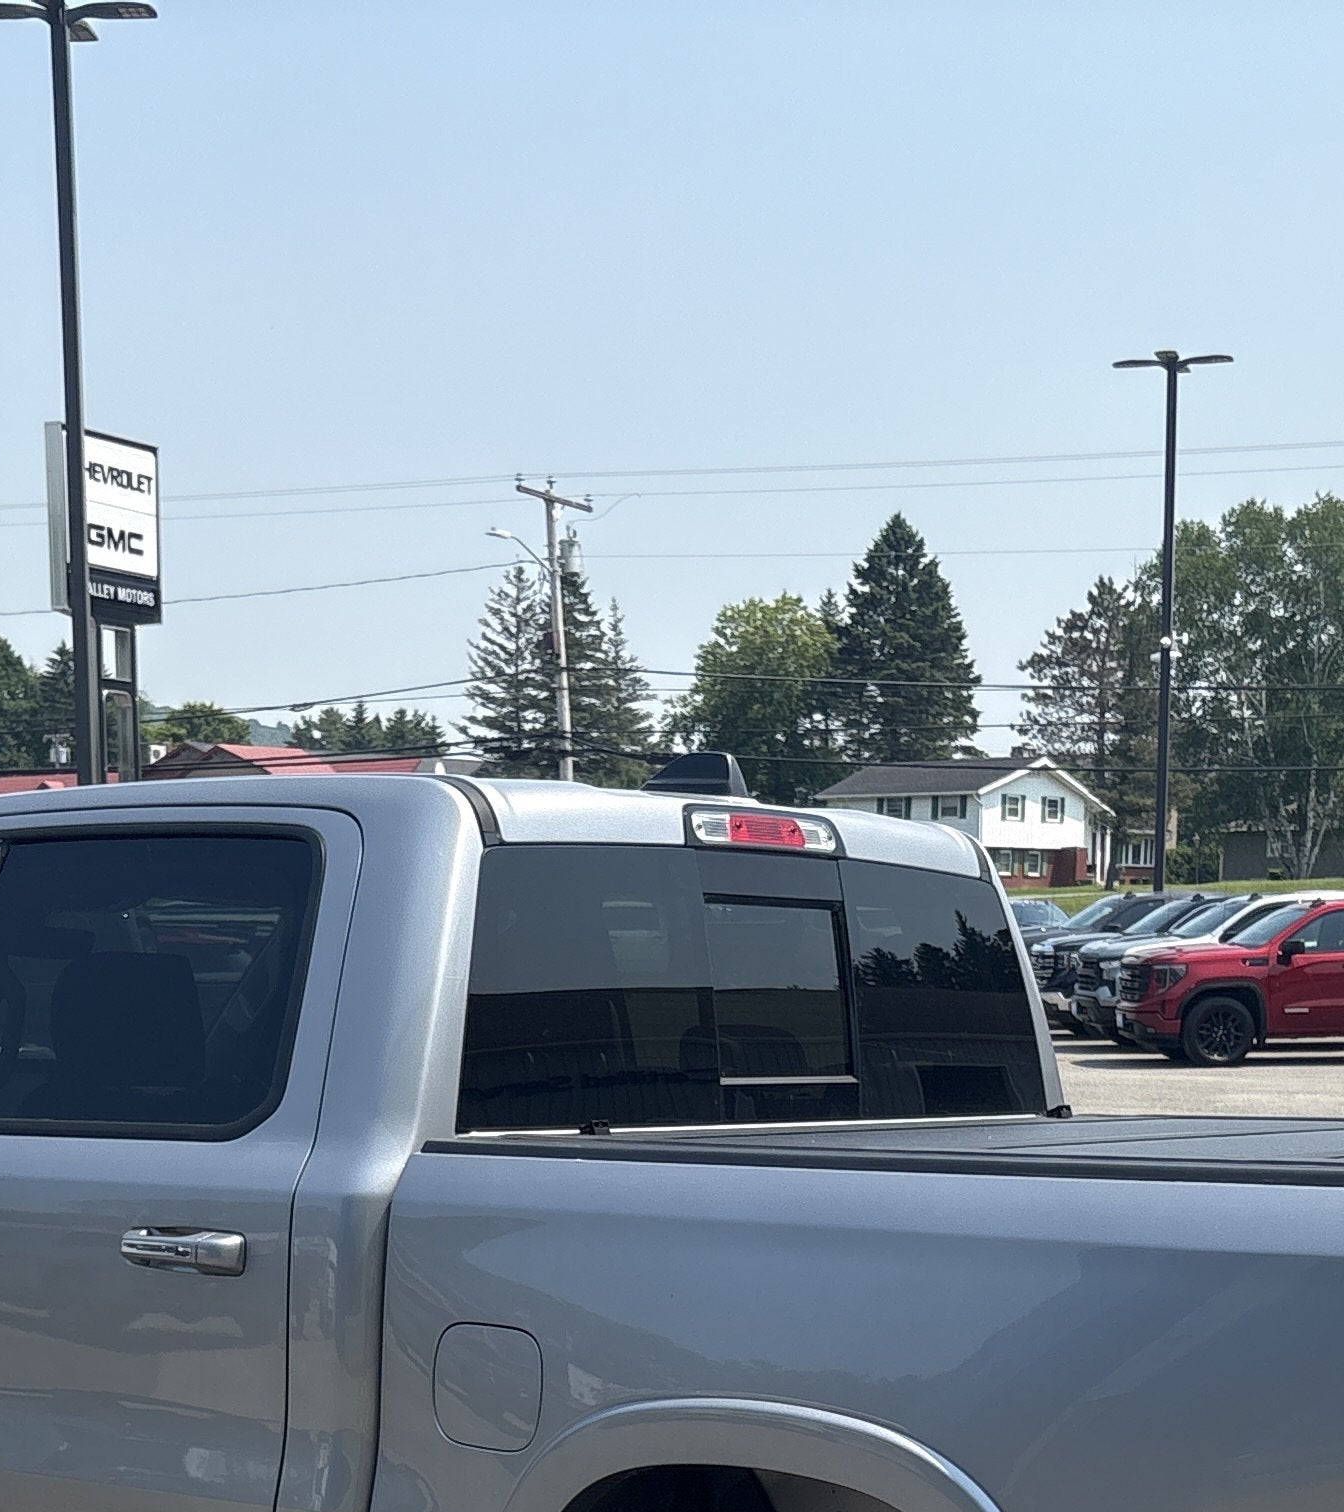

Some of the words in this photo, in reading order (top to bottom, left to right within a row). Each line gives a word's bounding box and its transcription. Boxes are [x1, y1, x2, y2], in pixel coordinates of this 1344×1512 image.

[85, 461, 153, 496] HEVROLET
[87, 523, 145, 556] GMC
[88, 581, 115, 600] ALLEY
[117, 586, 155, 607] MOTORS
